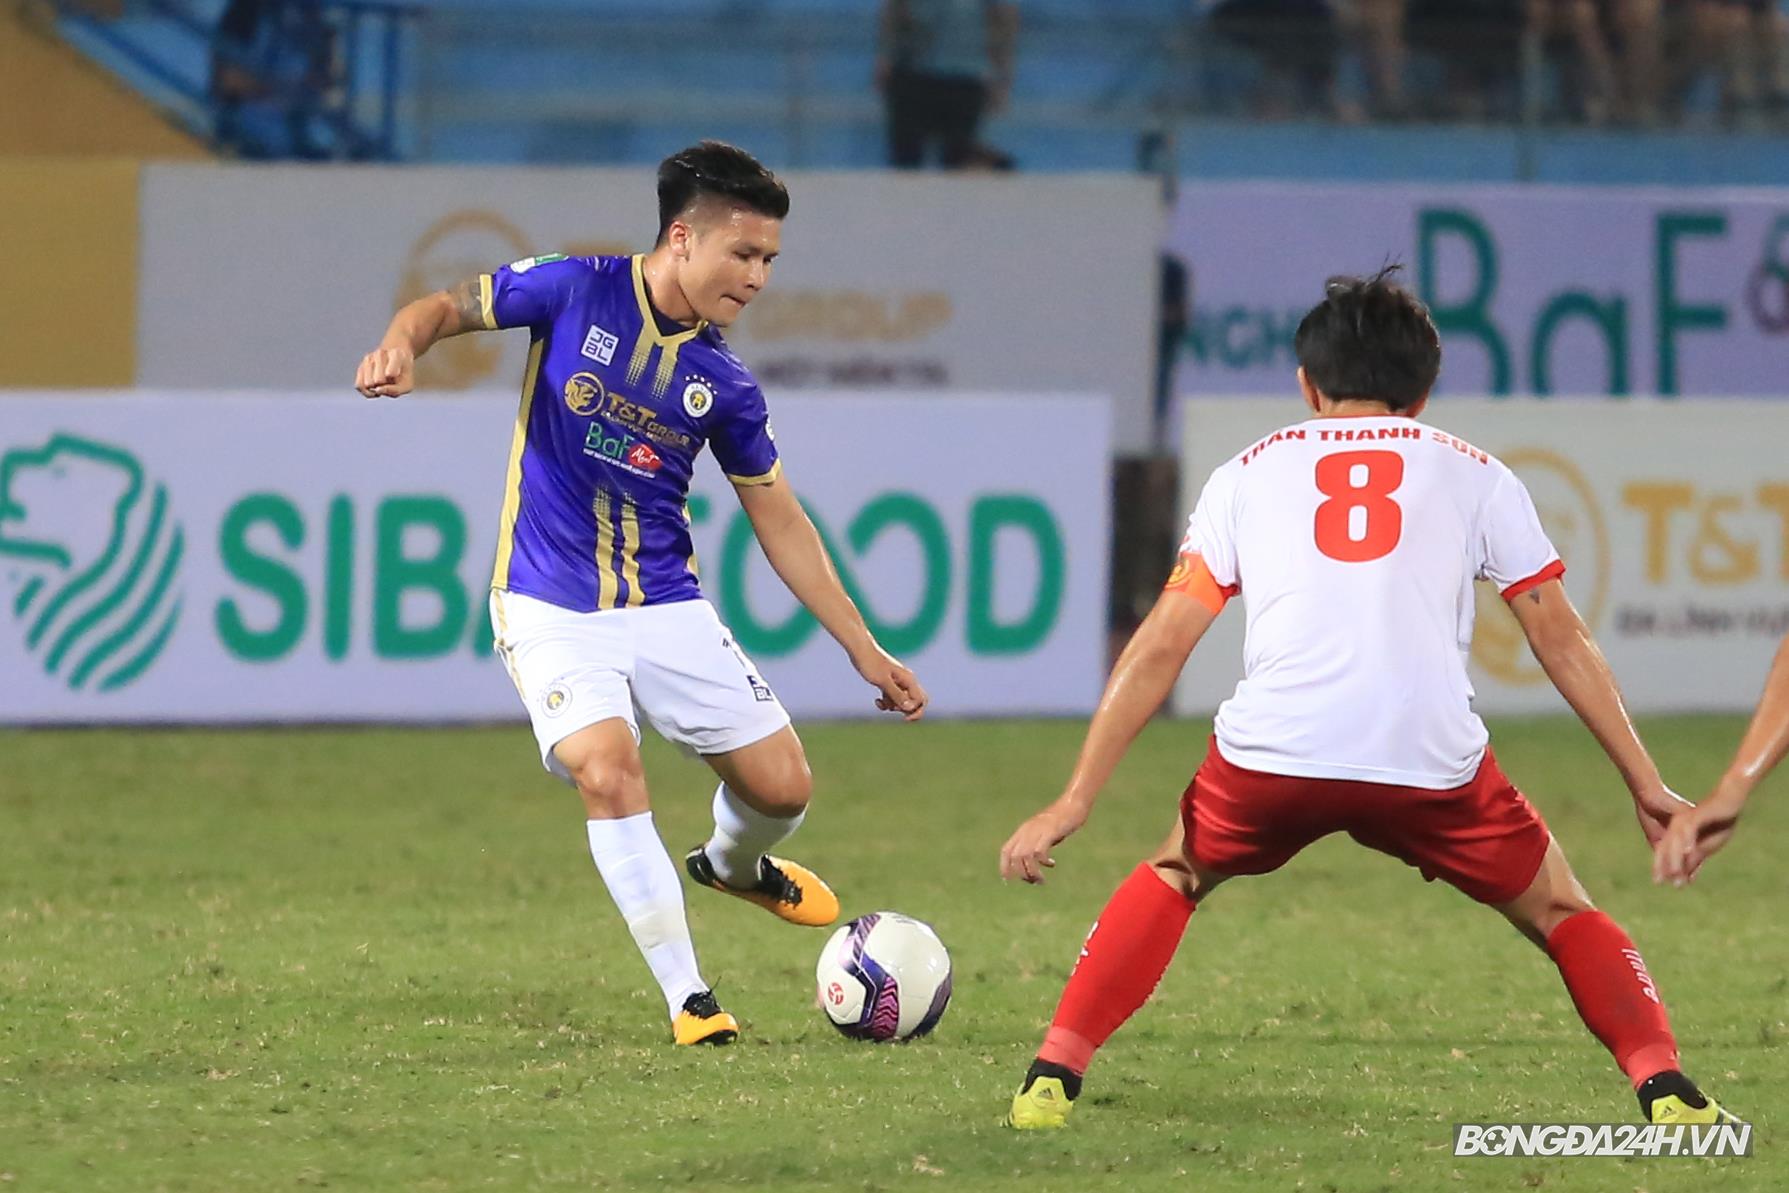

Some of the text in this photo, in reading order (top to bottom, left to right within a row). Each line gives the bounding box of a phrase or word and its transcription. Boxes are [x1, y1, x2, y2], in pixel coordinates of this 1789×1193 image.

[1415, 205, 1729, 398] BaF
[607, 391, 657, 427] T&T
[215, 491, 1065, 663] SIB OOD
[1314, 449, 1405, 563] 8
